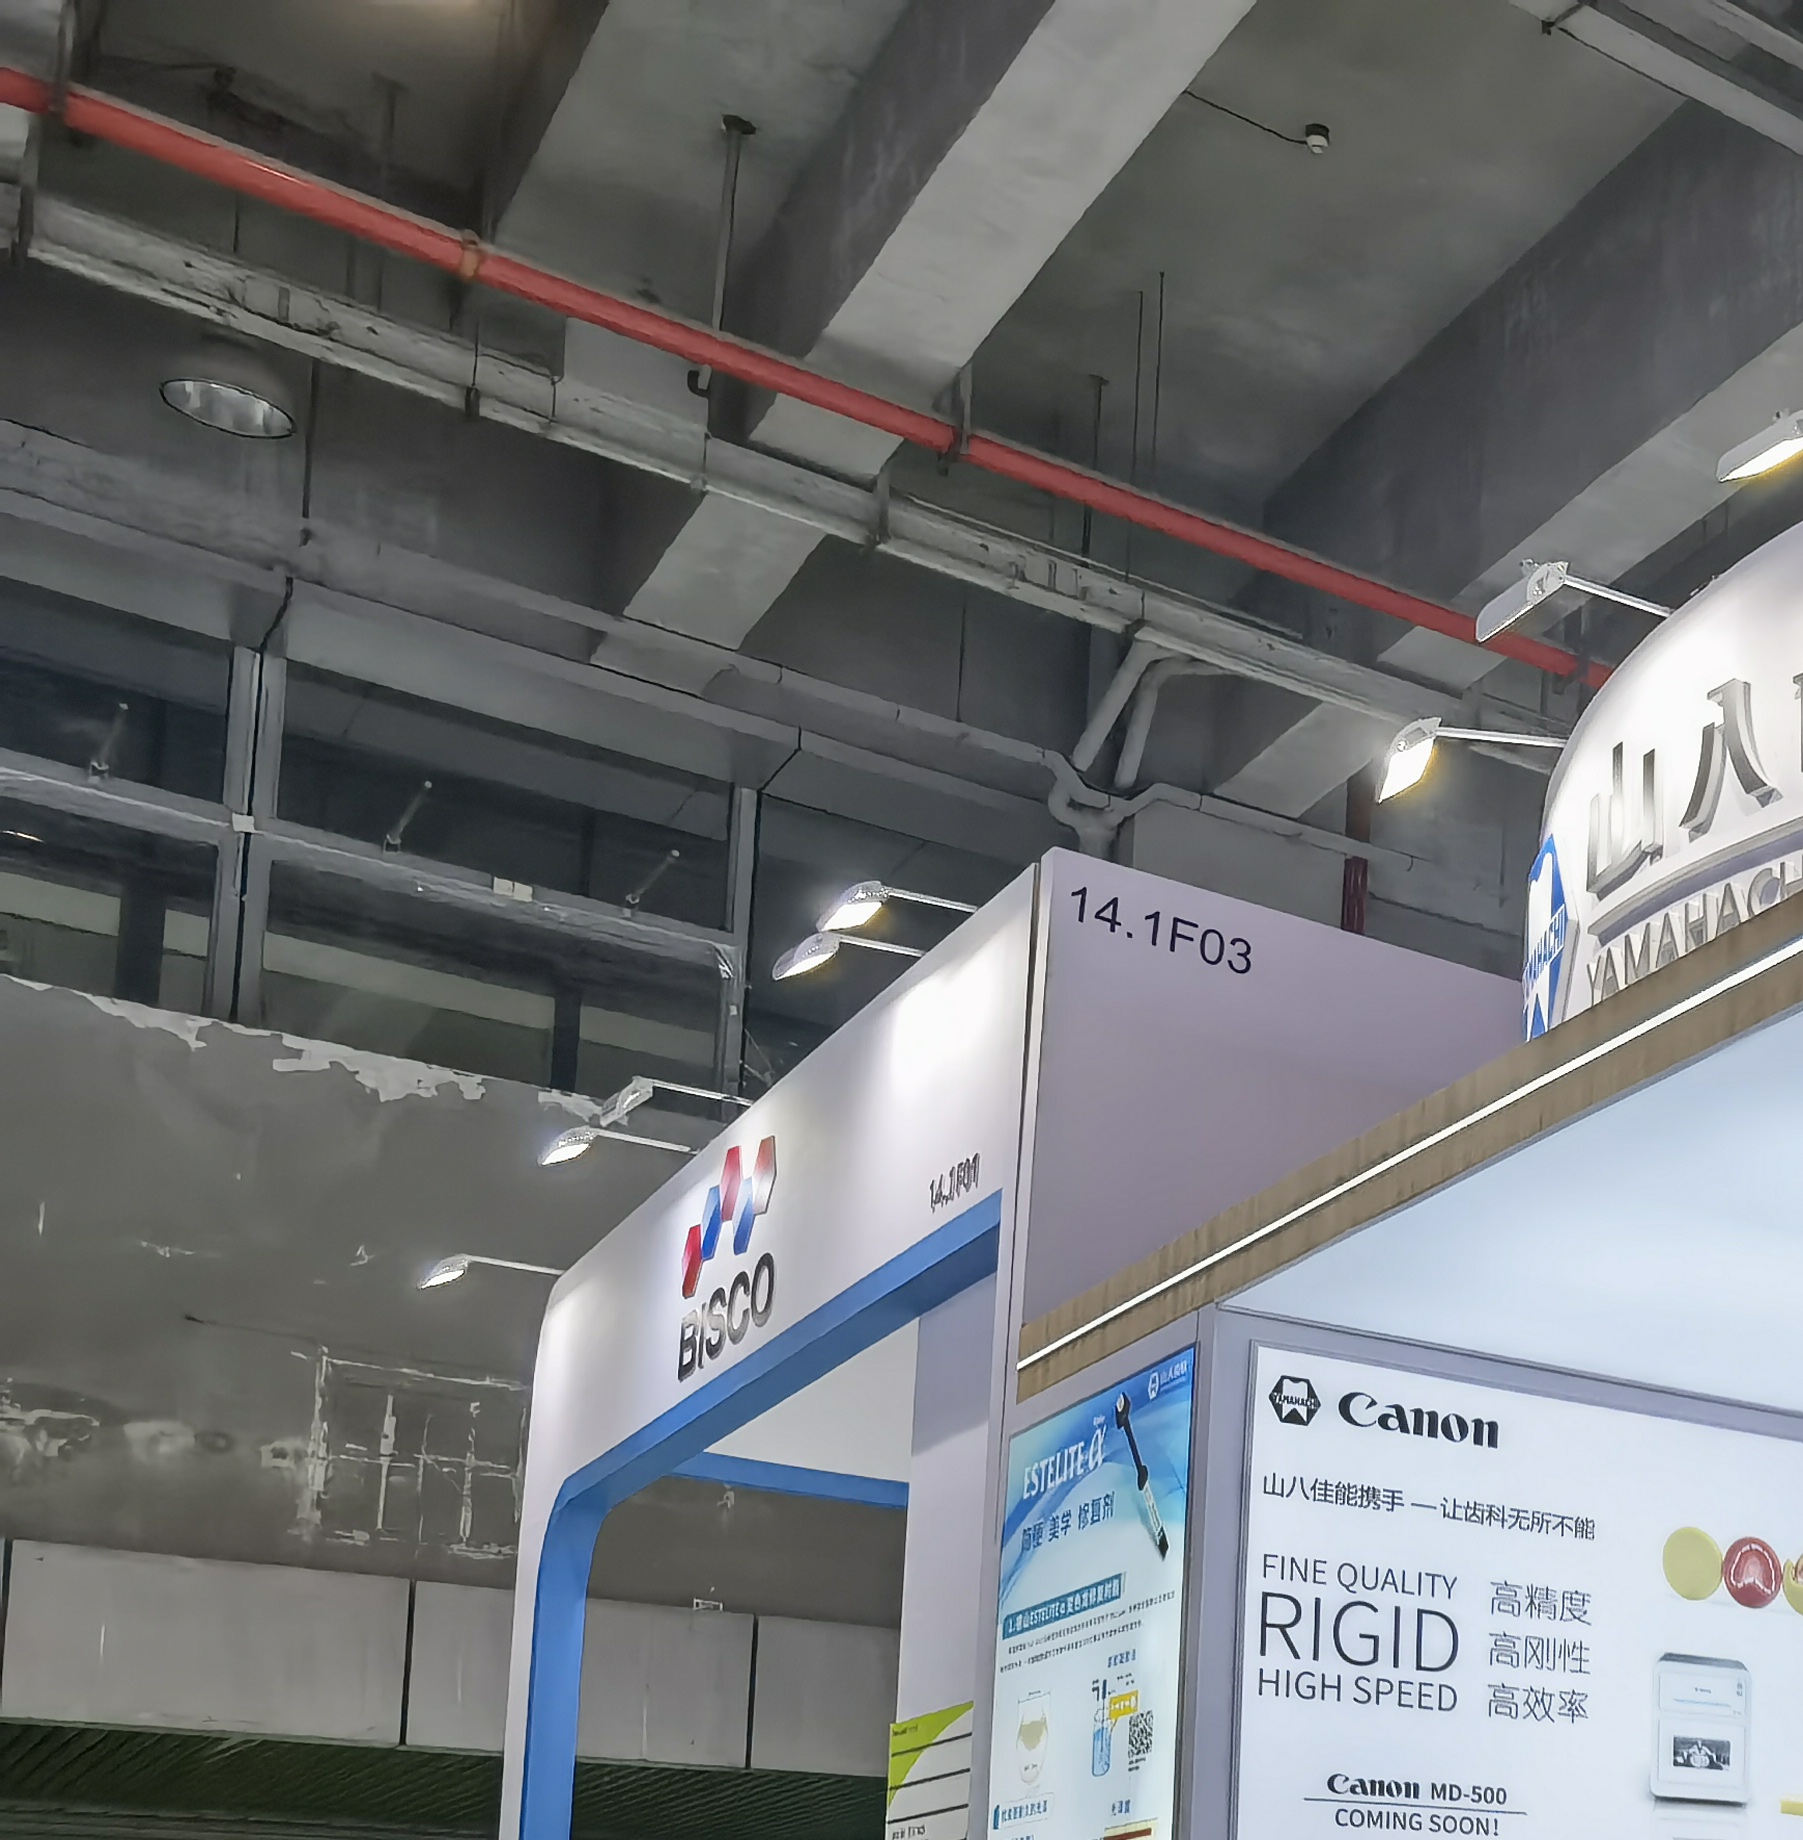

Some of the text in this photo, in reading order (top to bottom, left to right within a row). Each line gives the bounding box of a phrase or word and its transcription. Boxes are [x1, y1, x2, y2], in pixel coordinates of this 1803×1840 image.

[1069, 886, 1254, 976] 14.1F03
[679, 1252, 776, 1383] BISCO
[1338, 1391, 1500, 1449] Canon
[1023, 1441, 1086, 1500] ESTELITE
[1262, 1553, 1458, 1602] FINE QUALITY
[1488, 1579, 1592, 1627] 高精度
[1259, 1591, 1459, 1673] RIGID
[1487, 1631, 1591, 1678] 高刚性
[1258, 1667, 1458, 1713] HIGH SPEED
[1486, 1682, 1589, 1724] 高效率
[1326, 1773, 1507, 1806] Canon MD-500
[1334, 1808, 1501, 1838] COMING SOON!
